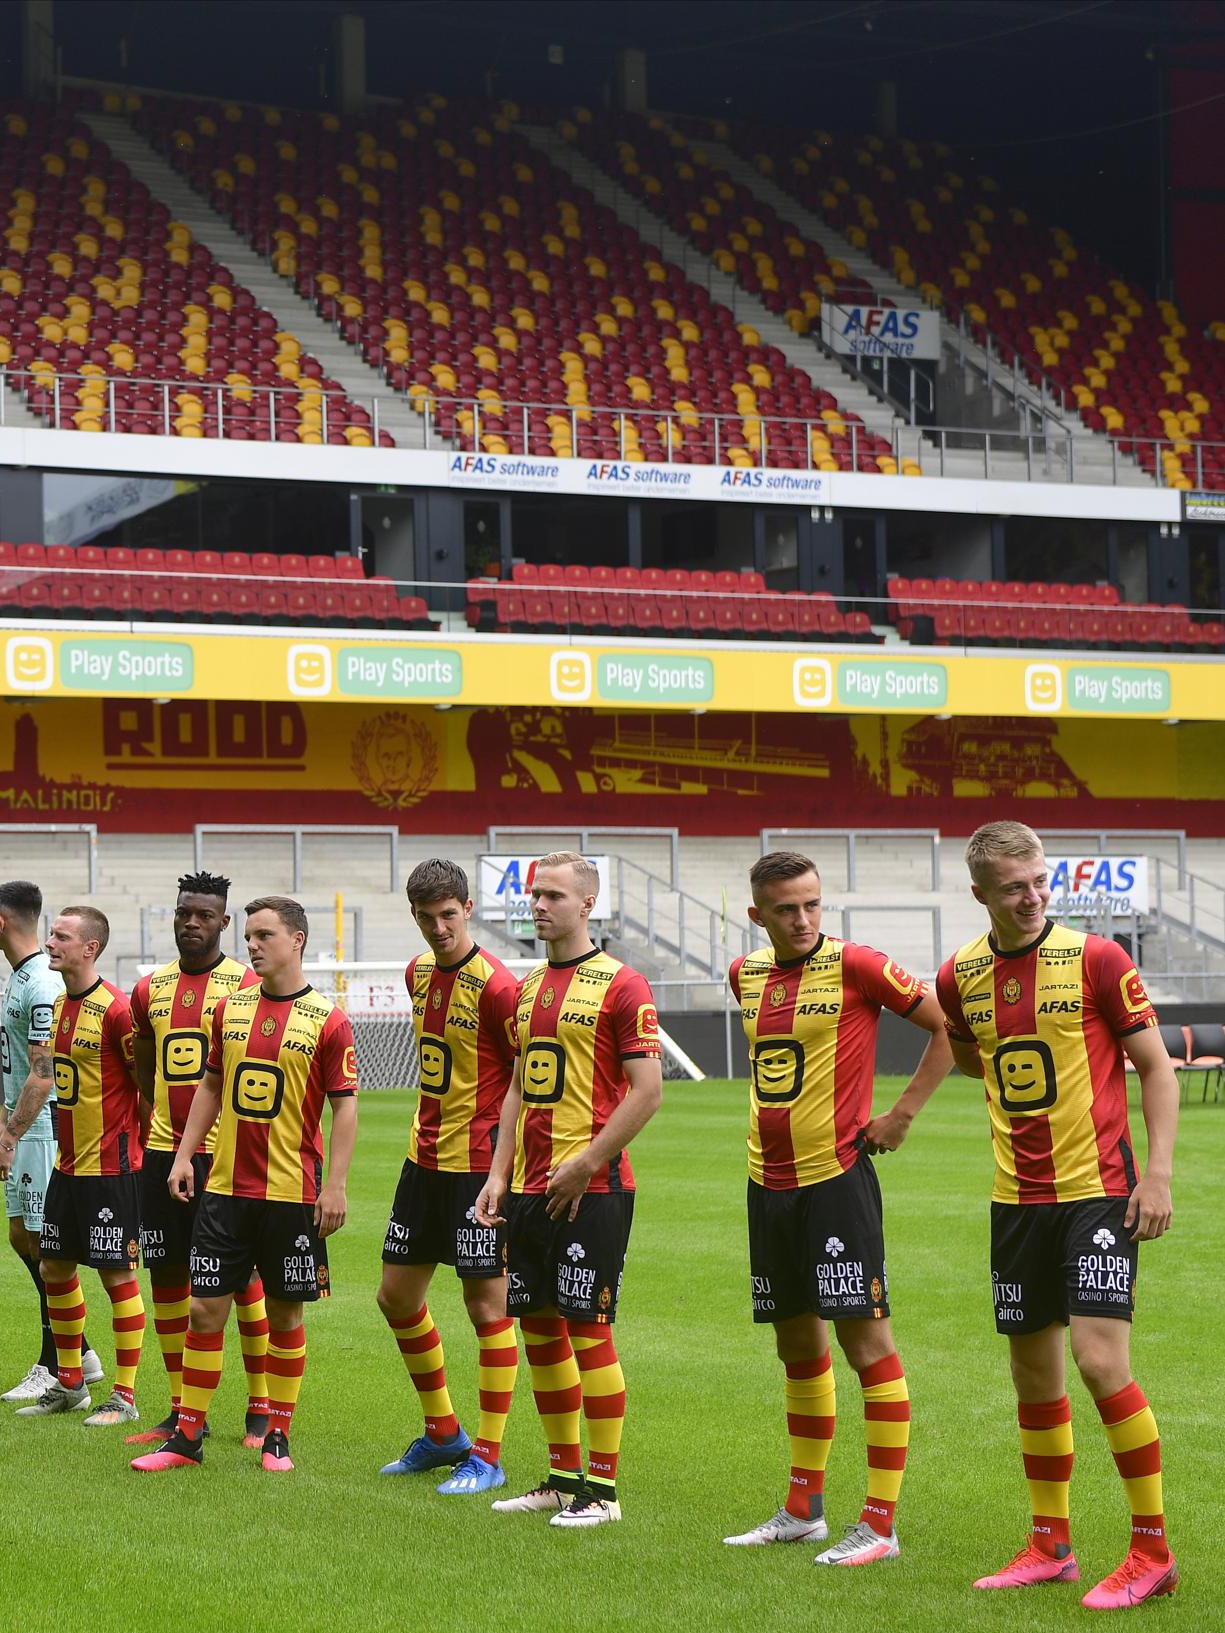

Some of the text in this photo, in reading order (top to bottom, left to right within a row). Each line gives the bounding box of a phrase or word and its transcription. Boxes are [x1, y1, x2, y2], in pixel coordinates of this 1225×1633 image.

[843, 308, 920, 338] AFAS
[451, 456, 559, 477] AFAS software
[587, 464, 691, 486] AFAS software
[721, 471, 821, 490] AFAS software
[70, 648, 184, 680] Play Sports
[347, 656, 453, 686] Play Sports
[606, 662, 705, 692] Play Sports
[845, 669, 939, 698] Play Sports
[1074, 674, 1163, 702] Play Sports
[103, 697, 308, 759] ROOD
[1050, 860, 1136, 892] AFAS
[1041, 948, 1081, 957] VERELST
[956, 956, 992, 972] VERELST
[152, 973, 179, 984] VERELST
[211, 972, 241, 982] VERELST
[459, 972, 484, 988] VERELST
[578, 968, 613, 980] VERELST
[295, 1001, 329, 1017] VERELST
[796, 1003, 840, 1016] AFAS
[1037, 1001, 1080, 1015] AFAS
[447, 1016, 478, 1029] AFAS
[560, 1011, 596, 1027] AFAS
[966, 1010, 993, 1026] AFAS
[73, 1038, 100, 1050] AFAS
[282, 1040, 315, 1055] AFAS
[90, 1226, 123, 1239] GOLDEN
[457, 1228, 496, 1242] GOLDEN
[40, 1238, 61, 1250] airco
[90, 1238, 122, 1251] PALACE
[384, 1239, 409, 1254] airco
[457, 1242, 496, 1257] PALACE
[478, 1258, 496, 1266] SPORTS
[1078, 1255, 1130, 1273] GOLDEN
[558, 1262, 596, 1284] GOLDEN
[816, 1262, 863, 1279] GOLDEN
[193, 1274, 220, 1286] airco
[558, 1277, 593, 1299] PALACE
[818, 1277, 865, 1296] PALACE
[1079, 1272, 1129, 1292] PALACE
[572, 1299, 590, 1309] SPORTS
[843, 1296, 867, 1306] SPORTS
[1078, 1291, 1128, 1304] CASINO SPORTS
[998, 1305, 1024, 1321] airco
